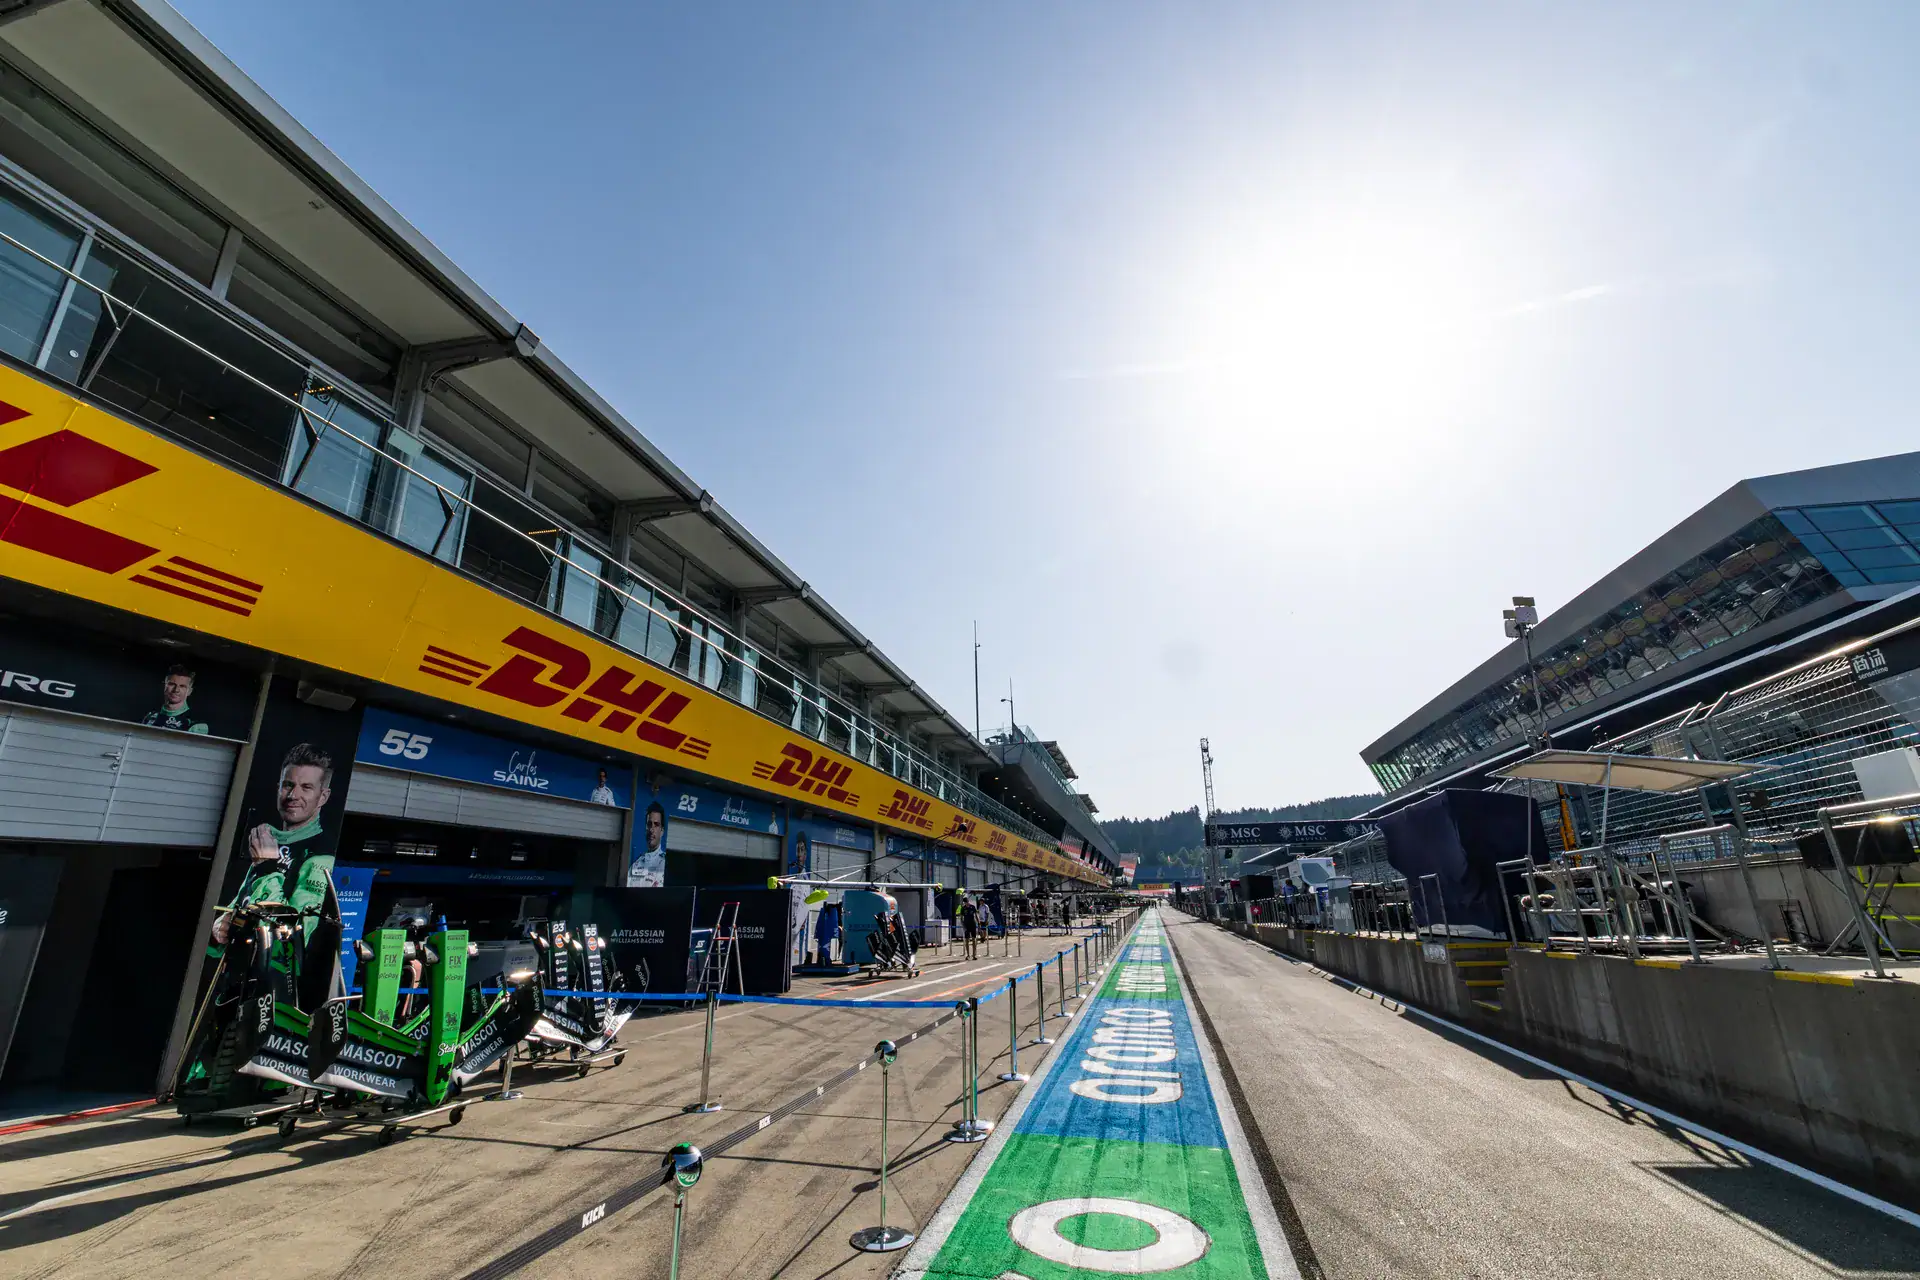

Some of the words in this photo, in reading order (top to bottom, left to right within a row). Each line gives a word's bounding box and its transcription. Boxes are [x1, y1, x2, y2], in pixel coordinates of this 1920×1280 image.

[1851, 648, 1886, 673] 商汤
[1858, 666, 1889, 680] sensetime
[476, 626, 692, 752] DHL
[379, 728, 433, 760] 55
[508, 750, 538, 776] Carlos
[770, 742, 853, 806] DHL
[493, 770, 549, 790] SAINZ
[678, 794, 698, 813] 23
[886, 789, 931, 828] DHL
[721, 813, 750, 826] ALBON
[1294, 825, 1327, 837] MSC
[1230, 827, 1261, 839] MSC
[552, 922, 565, 934] 23
[585, 926, 597, 937] 55
[618, 929, 665, 938] ATLASSIAN
[384, 954, 398, 964] FIX
[449, 955, 462, 965] FIX
[258, 993, 272, 1033] Stake
[329, 1001, 345, 1043] Stake
[461, 1019, 498, 1057] MASCOT
[339, 1043, 406, 1070] MASCOT
[465, 1036, 505, 1072] WORKWEAR
[1069, 1006, 1184, 1105] aramco
[333, 1065, 397, 1089] WORKWEAR
[582, 1203, 606, 1228] KICK
